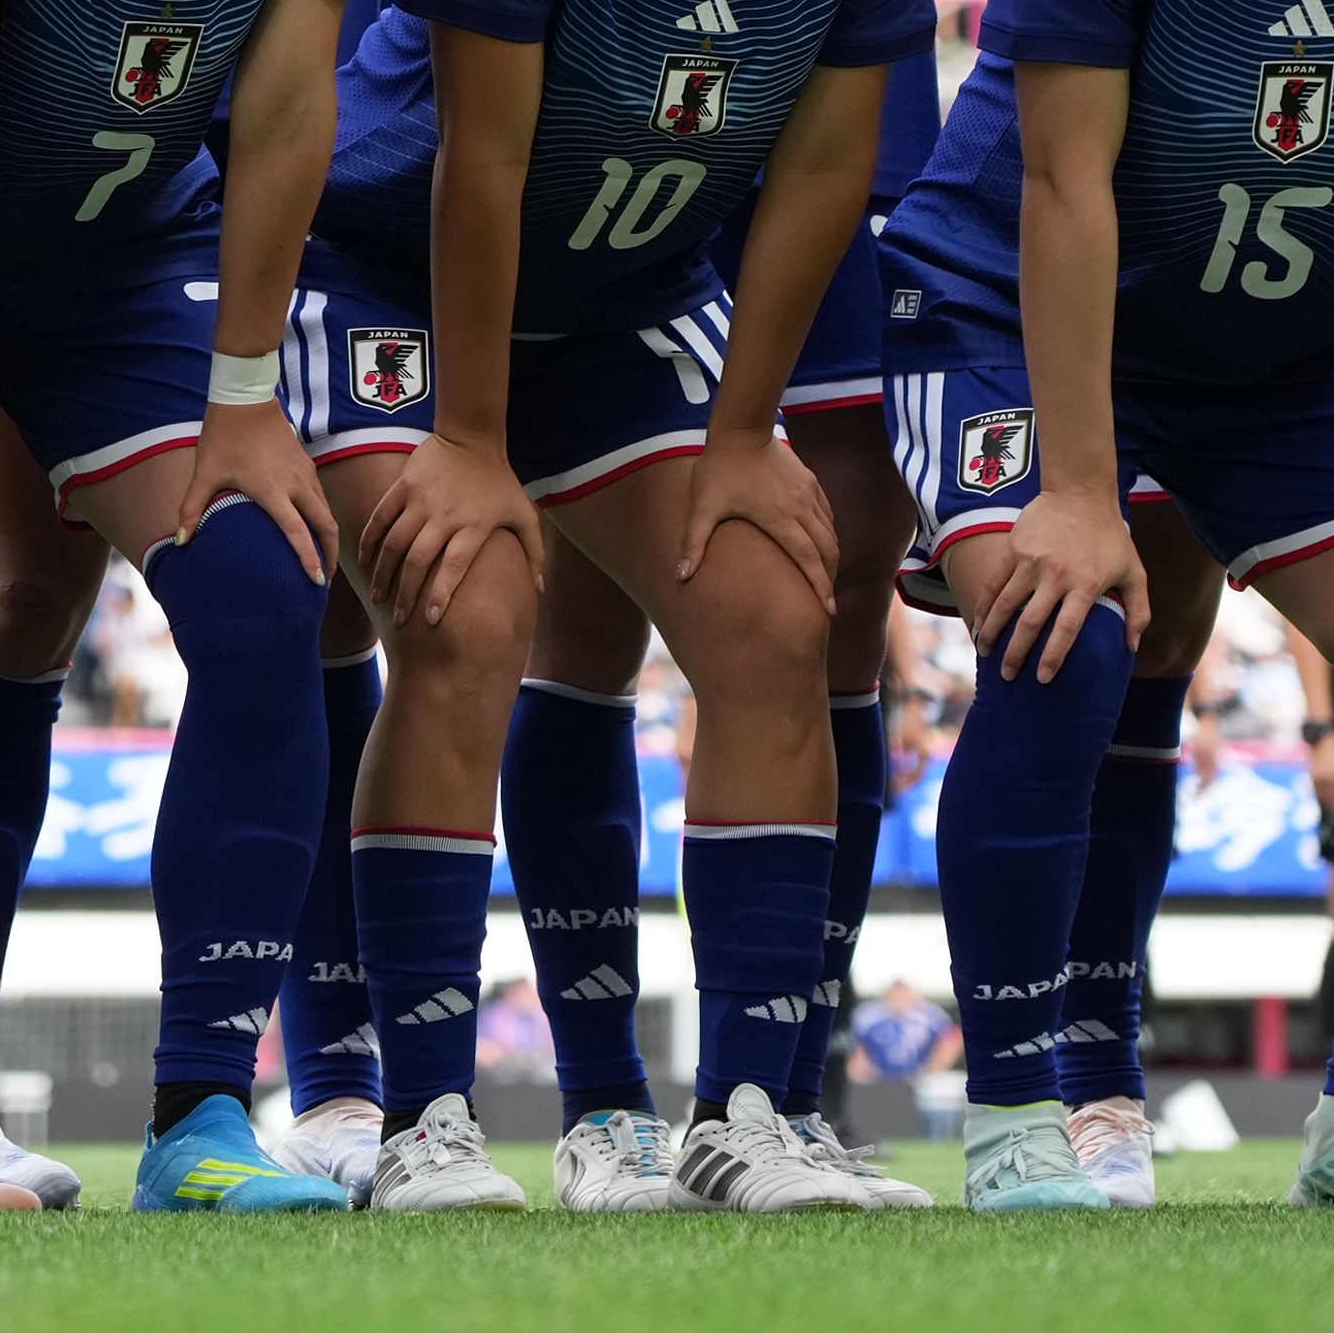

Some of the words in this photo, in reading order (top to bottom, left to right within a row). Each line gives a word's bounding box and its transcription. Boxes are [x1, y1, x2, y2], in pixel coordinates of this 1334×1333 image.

[142, 25, 184, 35] JAPAN
[682, 59, 719, 68] JAPAN
[1278, 66, 1316, 74] JAPAN
[128, 82, 162, 97] JFA
[1270, 128, 1304, 144] JFA
[74, 131, 155, 221] 7
[568, 157, 707, 250] 10
[1200, 183, 1333, 299] 15
[368, 331, 409, 339] JAPAN
[372, 385, 407, 398] JFA
[977, 412, 1017, 426] JAPAN
[974, 468, 1007, 483] JFA
[973, 965, 1069, 1000] JAPA
